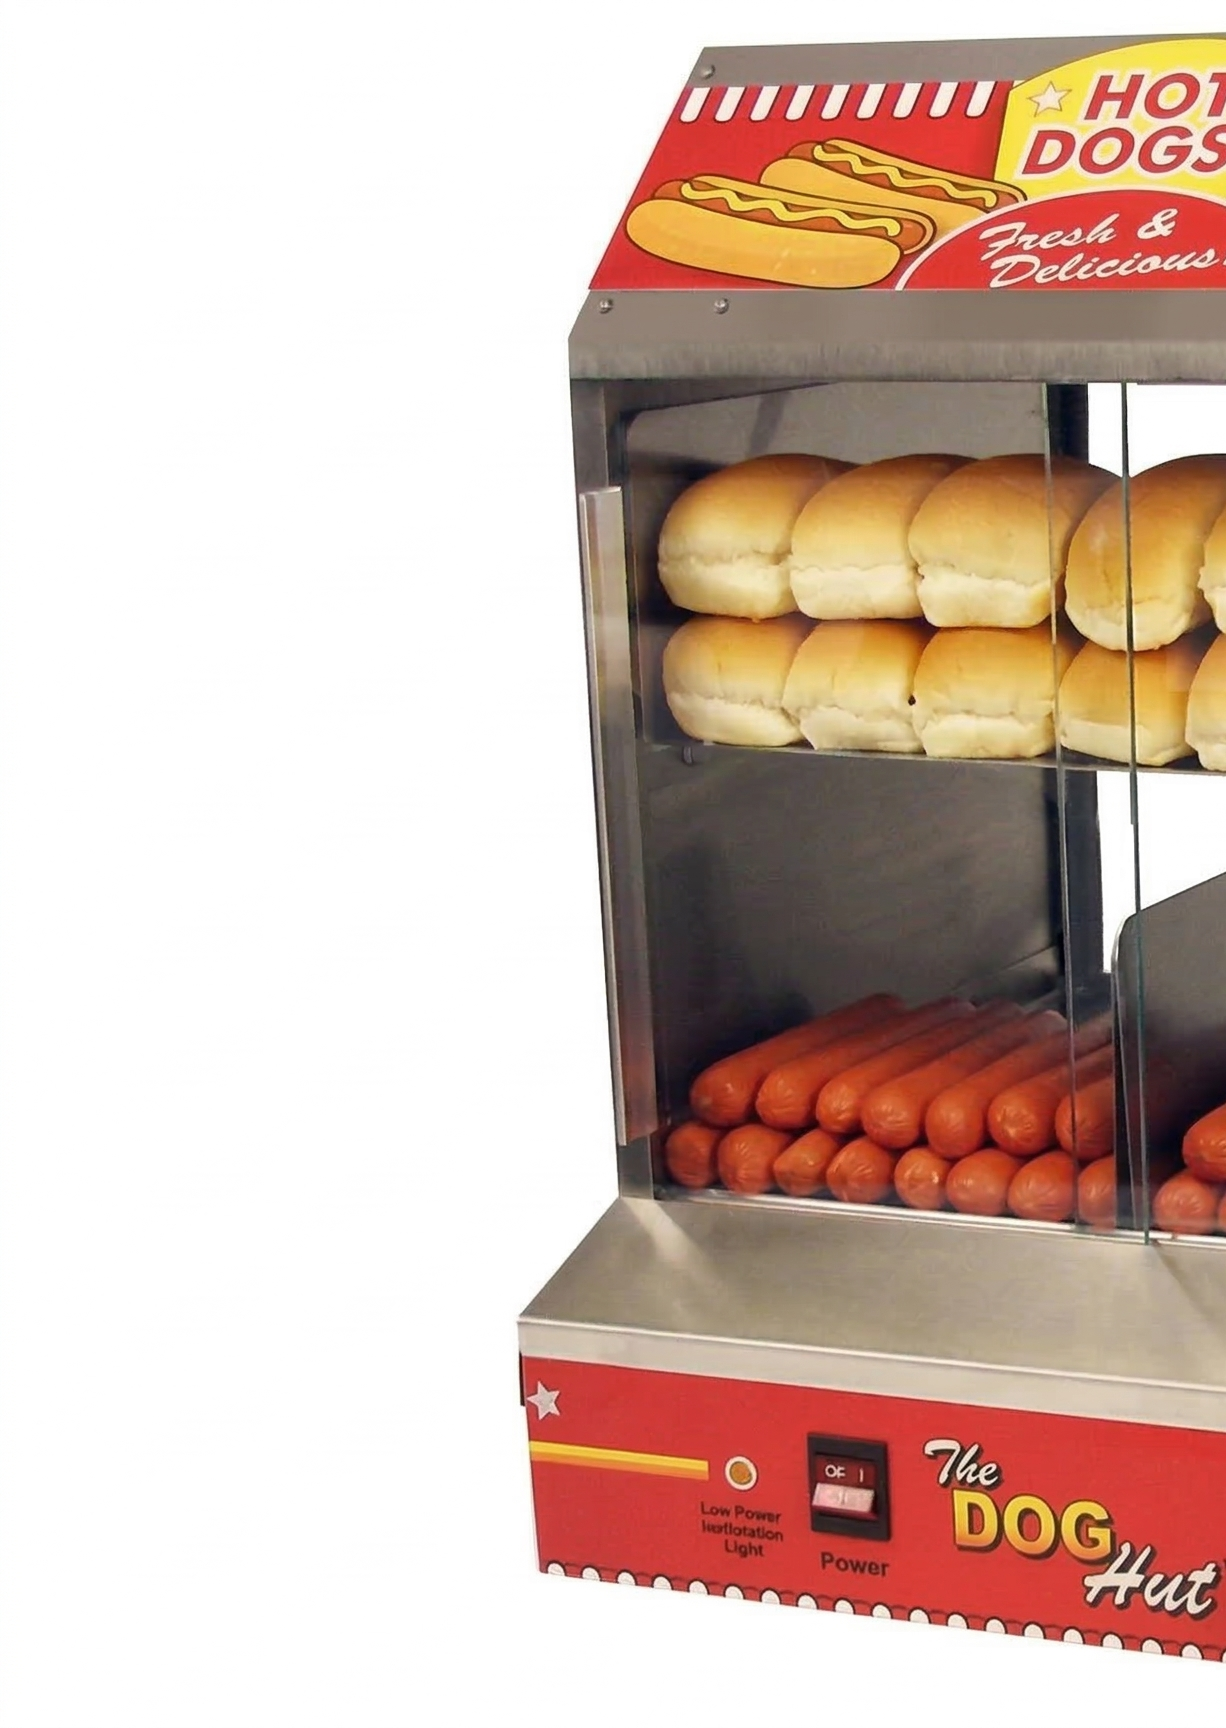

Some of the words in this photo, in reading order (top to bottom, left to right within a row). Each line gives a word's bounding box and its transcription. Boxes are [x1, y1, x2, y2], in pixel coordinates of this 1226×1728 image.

[979, 212, 1120, 261] Fresh
[1136, 207, 1178, 239] &
[922, 1438, 1003, 1487] The
[700, 1500, 731, 1517] Low
[734, 1504, 782, 1524] Power
[950, 1487, 1115, 1561] DOG
[724, 1538, 764, 1559] Light
[820, 1550, 890, 1578] Power
[1082, 1541, 1223, 1616] Hut
